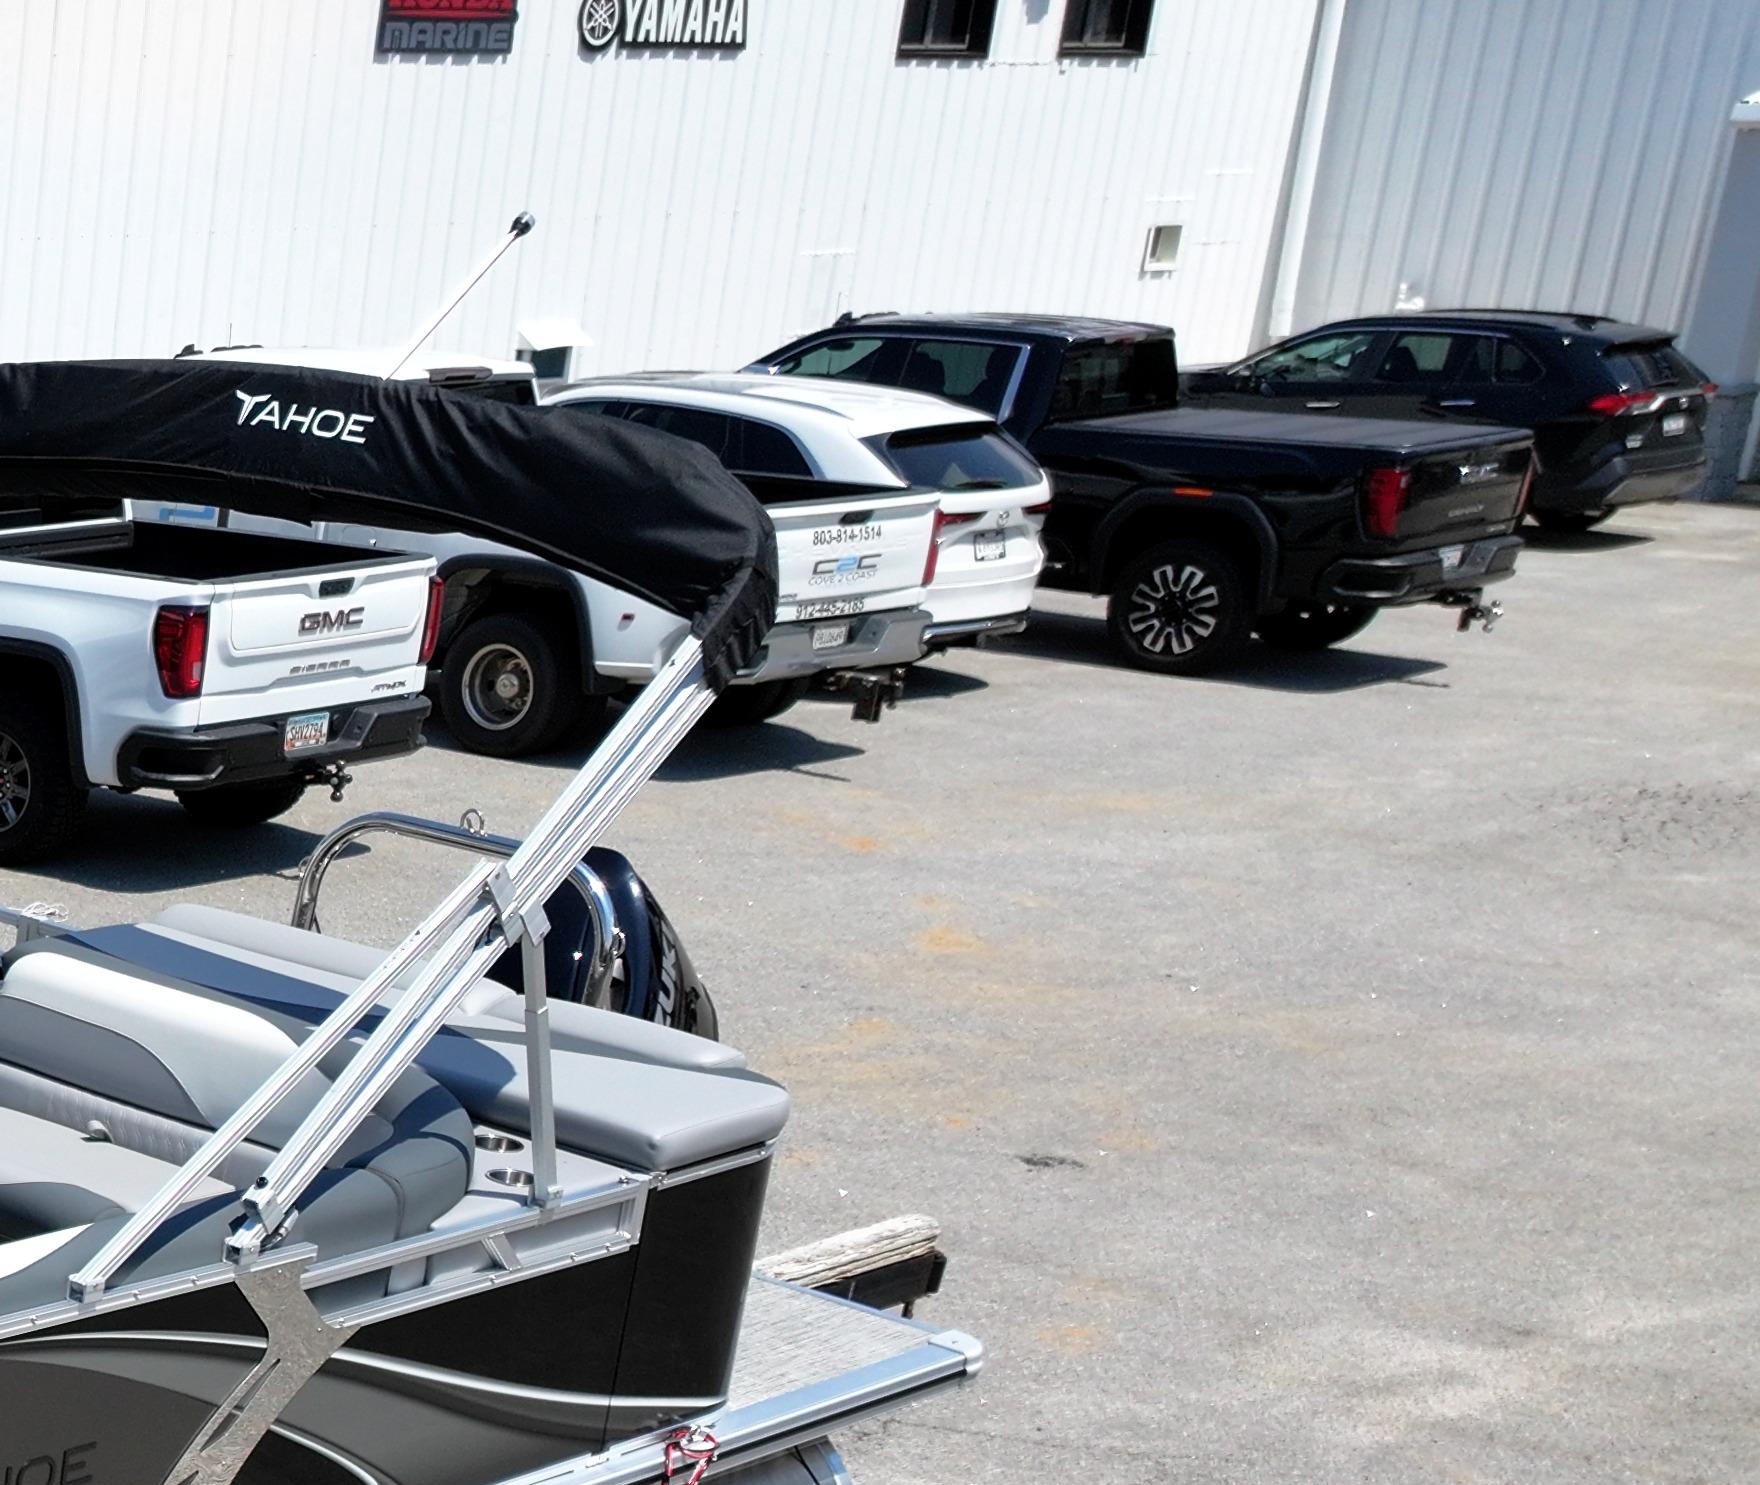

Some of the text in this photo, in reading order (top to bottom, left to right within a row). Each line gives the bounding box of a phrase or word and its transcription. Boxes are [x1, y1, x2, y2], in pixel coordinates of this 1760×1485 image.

[383, 22, 510, 49] MARINE
[623, 0, 744, 43] YAMAHA
[235, 389, 375, 444] TAHOE
[812, 525, 882, 546] 803-814-1514
[812, 554, 882, 575] C2C
[299, 606, 365, 636] GMC
